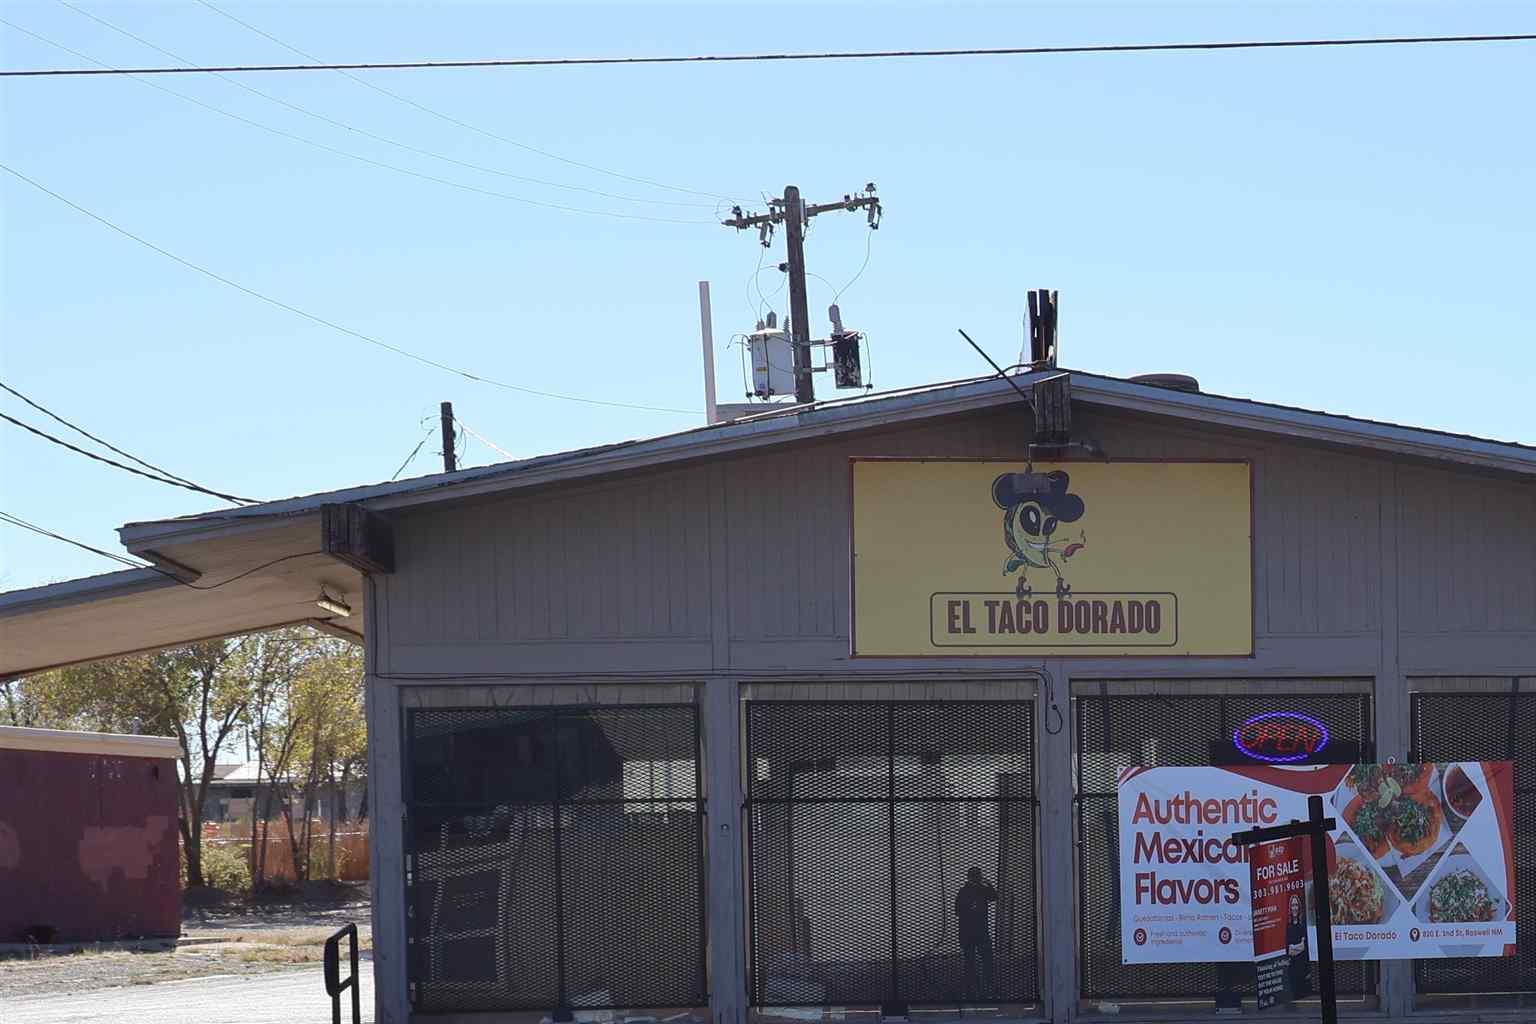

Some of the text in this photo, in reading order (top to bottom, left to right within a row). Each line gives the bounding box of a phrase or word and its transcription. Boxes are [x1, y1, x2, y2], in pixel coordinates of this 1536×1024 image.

[947, 600, 1161, 634] EL TACO DORADO
[1241, 722, 1319, 753] OPEN
[1132, 790, 1277, 824] Authentic
[1256, 865, 1275, 880] FOR
[1276, 859, 1299, 877] SALE
[1135, 872, 1240, 905] Flavors
[1335, 931, 1397, 941] El Taco Dorado
